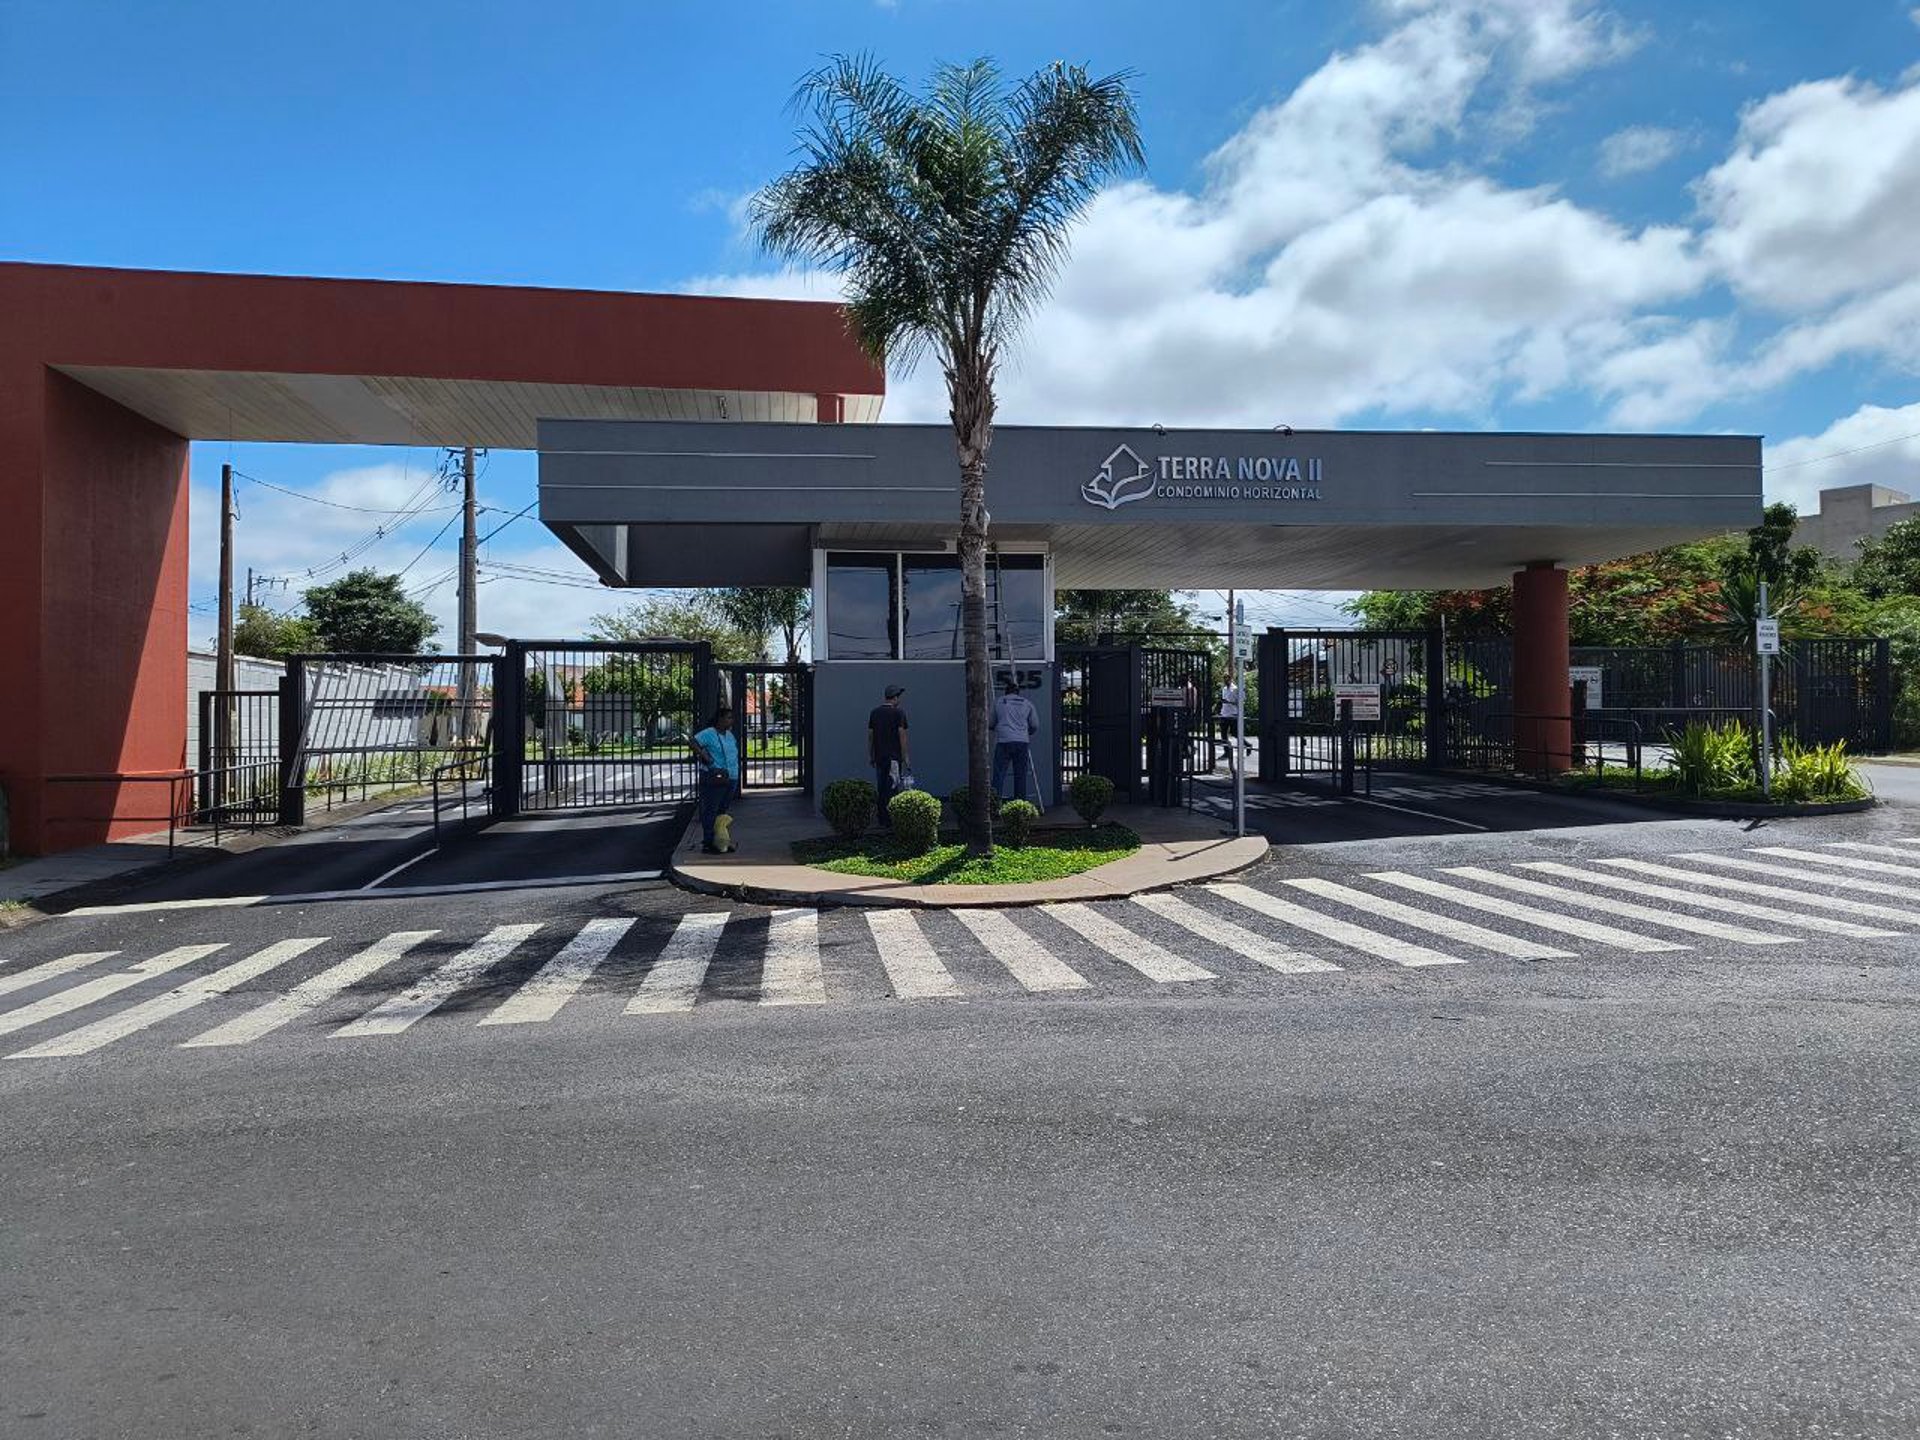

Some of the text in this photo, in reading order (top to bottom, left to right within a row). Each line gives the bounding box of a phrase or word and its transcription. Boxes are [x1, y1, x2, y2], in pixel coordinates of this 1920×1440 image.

[1157, 456, 1323, 481] TERRA NOVA II
[1157, 486, 1322, 499] CONDOMINIO HORIZONTAL
